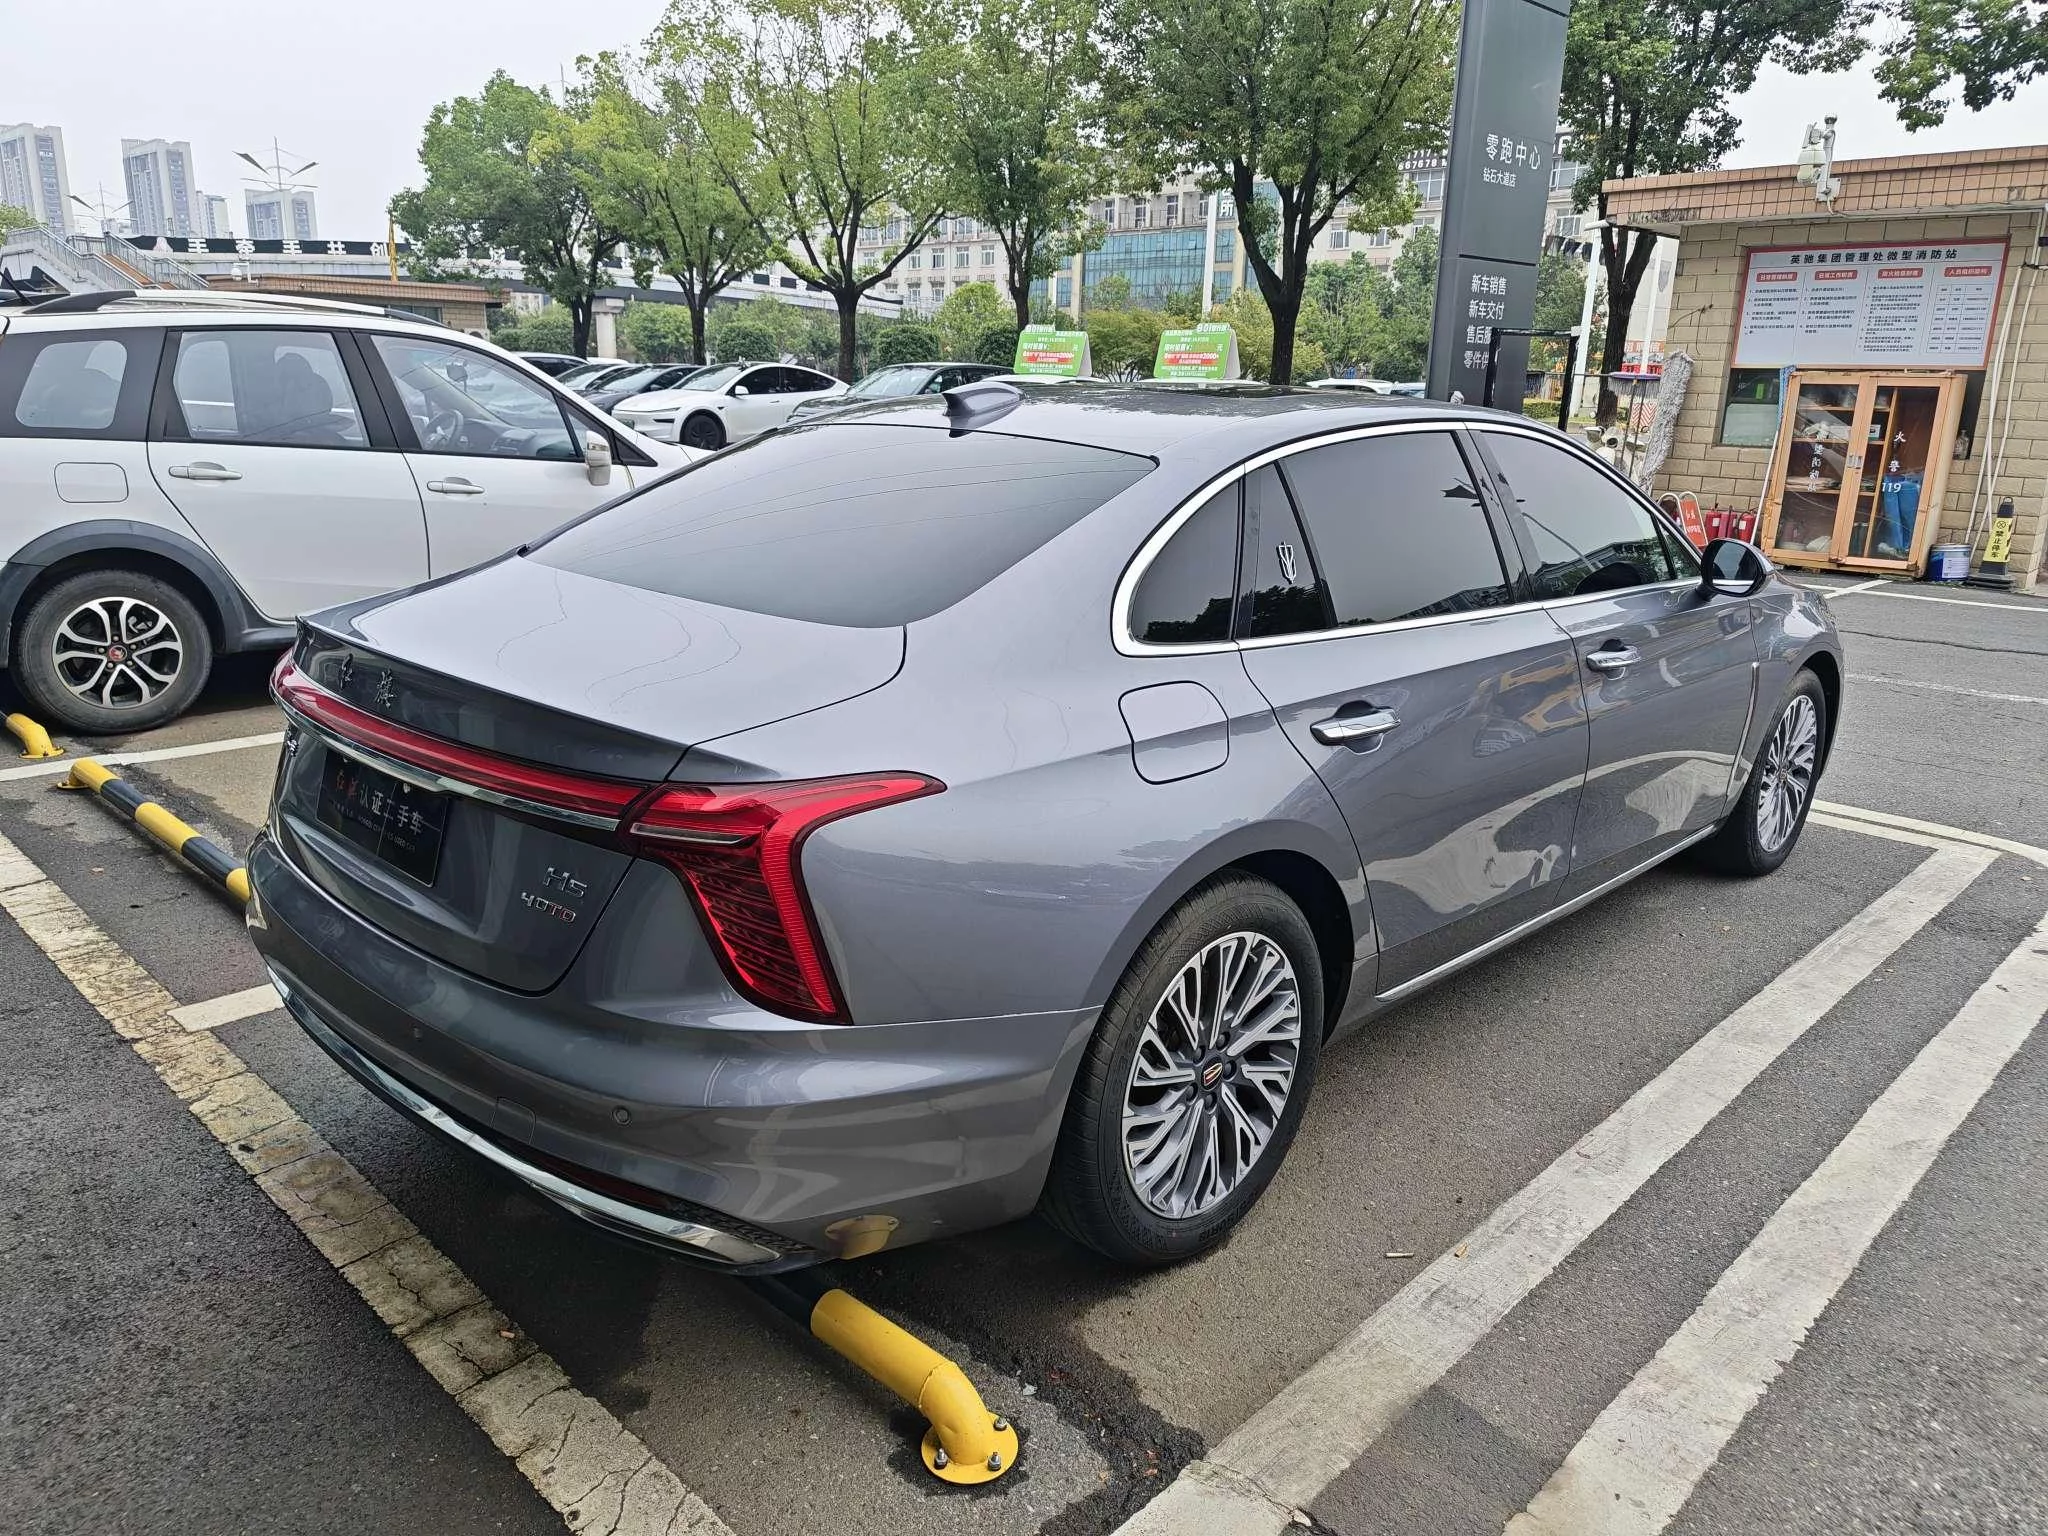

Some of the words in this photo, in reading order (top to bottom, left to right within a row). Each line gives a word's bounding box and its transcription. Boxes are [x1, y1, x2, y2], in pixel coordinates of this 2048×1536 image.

[1486, 133, 1541, 170] 零跑中心
[1483, 167, 1517, 188] 钻石大道店
[1790, 249, 1959, 266] 英驰集团管理处微型消防站
[1471, 274, 1507, 295] 新车销售
[1468, 300, 1504, 320] 新车交付
[1466, 324, 1492, 345] 售后服
[1464, 349, 1493, 369] 零件供
[1882, 482, 1902, 493] 119
[1991, 530, 2005, 559] 禁止停车
[543, 867, 588, 897] H5
